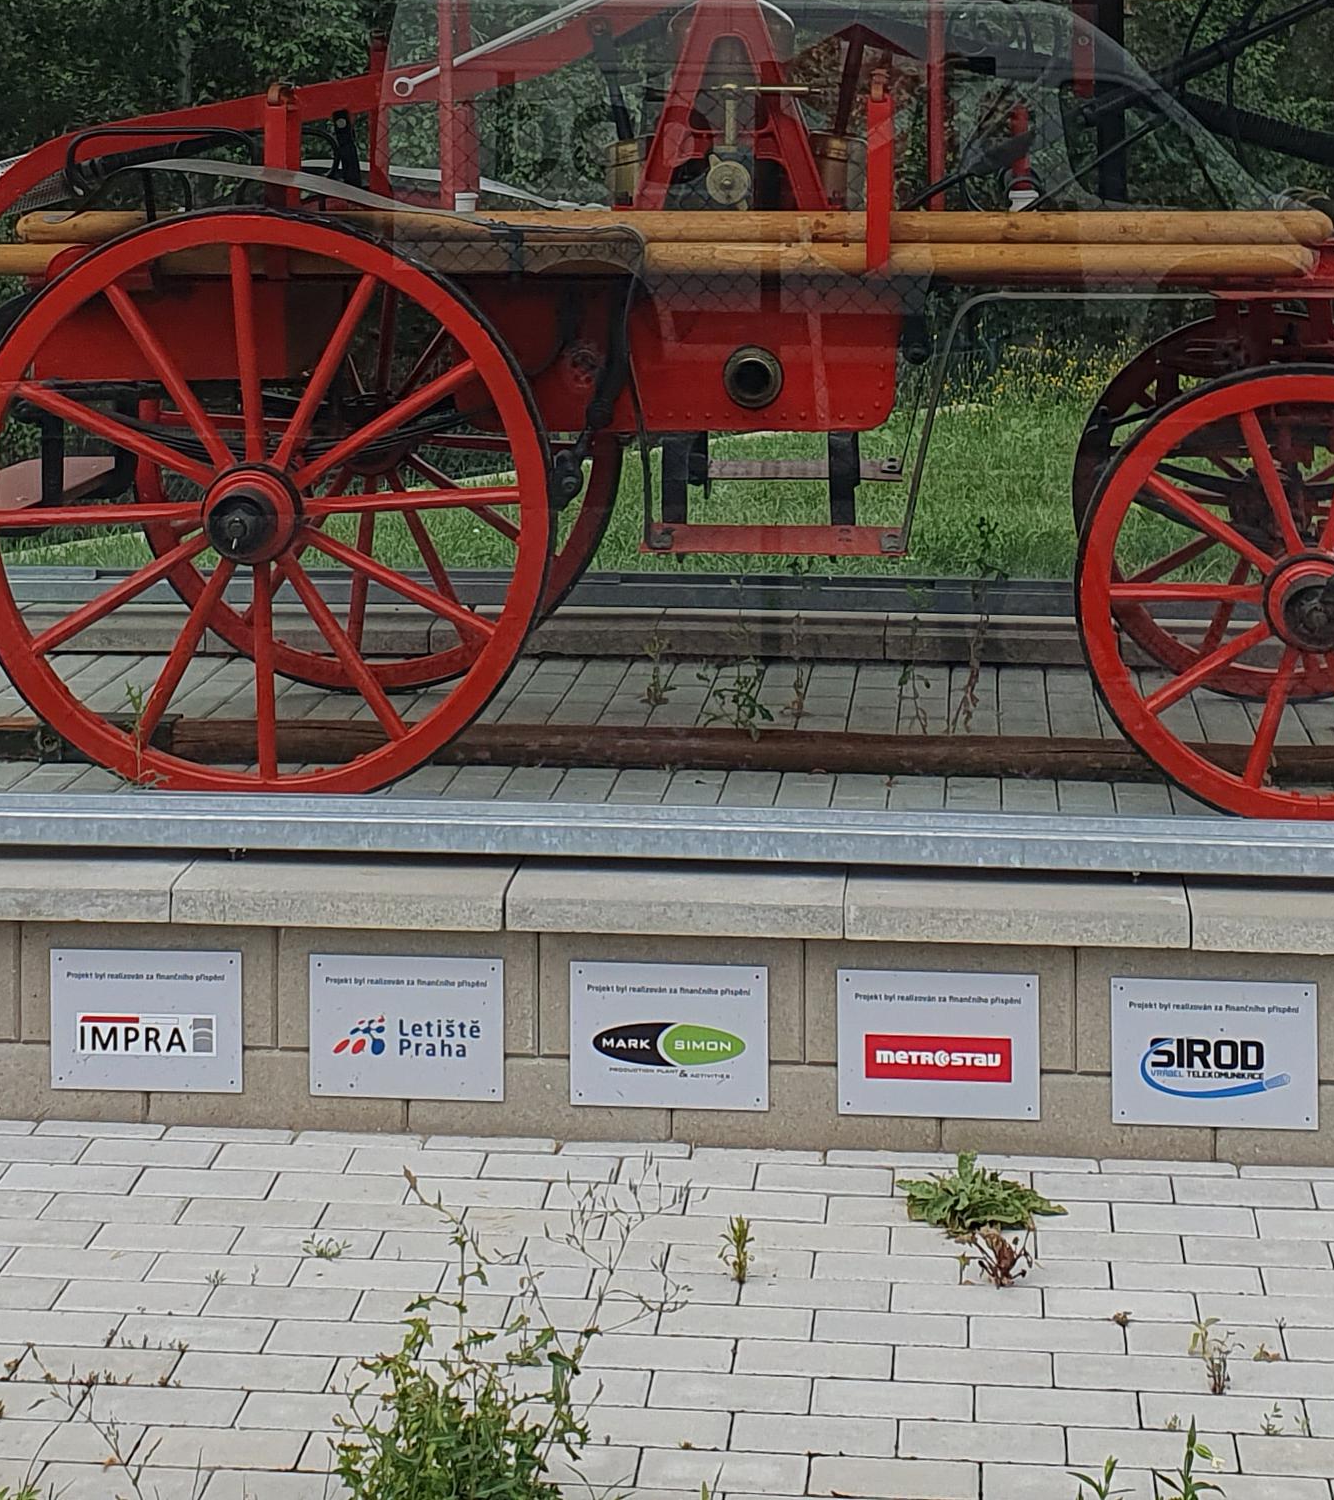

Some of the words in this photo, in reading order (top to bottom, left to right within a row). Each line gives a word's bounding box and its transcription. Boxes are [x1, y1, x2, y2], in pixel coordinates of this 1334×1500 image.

[66, 971, 93, 980] Projekt
[95, 972, 106, 980] byl
[325, 976, 352, 985] Projekt
[354, 976, 365, 986] byl
[586, 984, 614, 992] Projekt
[616, 985, 628, 994] byl
[854, 992, 882, 1001] Projekt
[884, 993, 896, 1002] byl
[1128, 1001, 1157, 1009] Projekt
[1158, 1001, 1170, 1011] byl
[399, 1019, 481, 1038] Letiště
[80, 1025, 186, 1053] IMPRA
[602, 1037, 651, 1050] MARK
[674, 1040, 732, 1051] SIMON
[399, 1039, 467, 1058] Praha
[1150, 1037, 1264, 1070] SIROD
